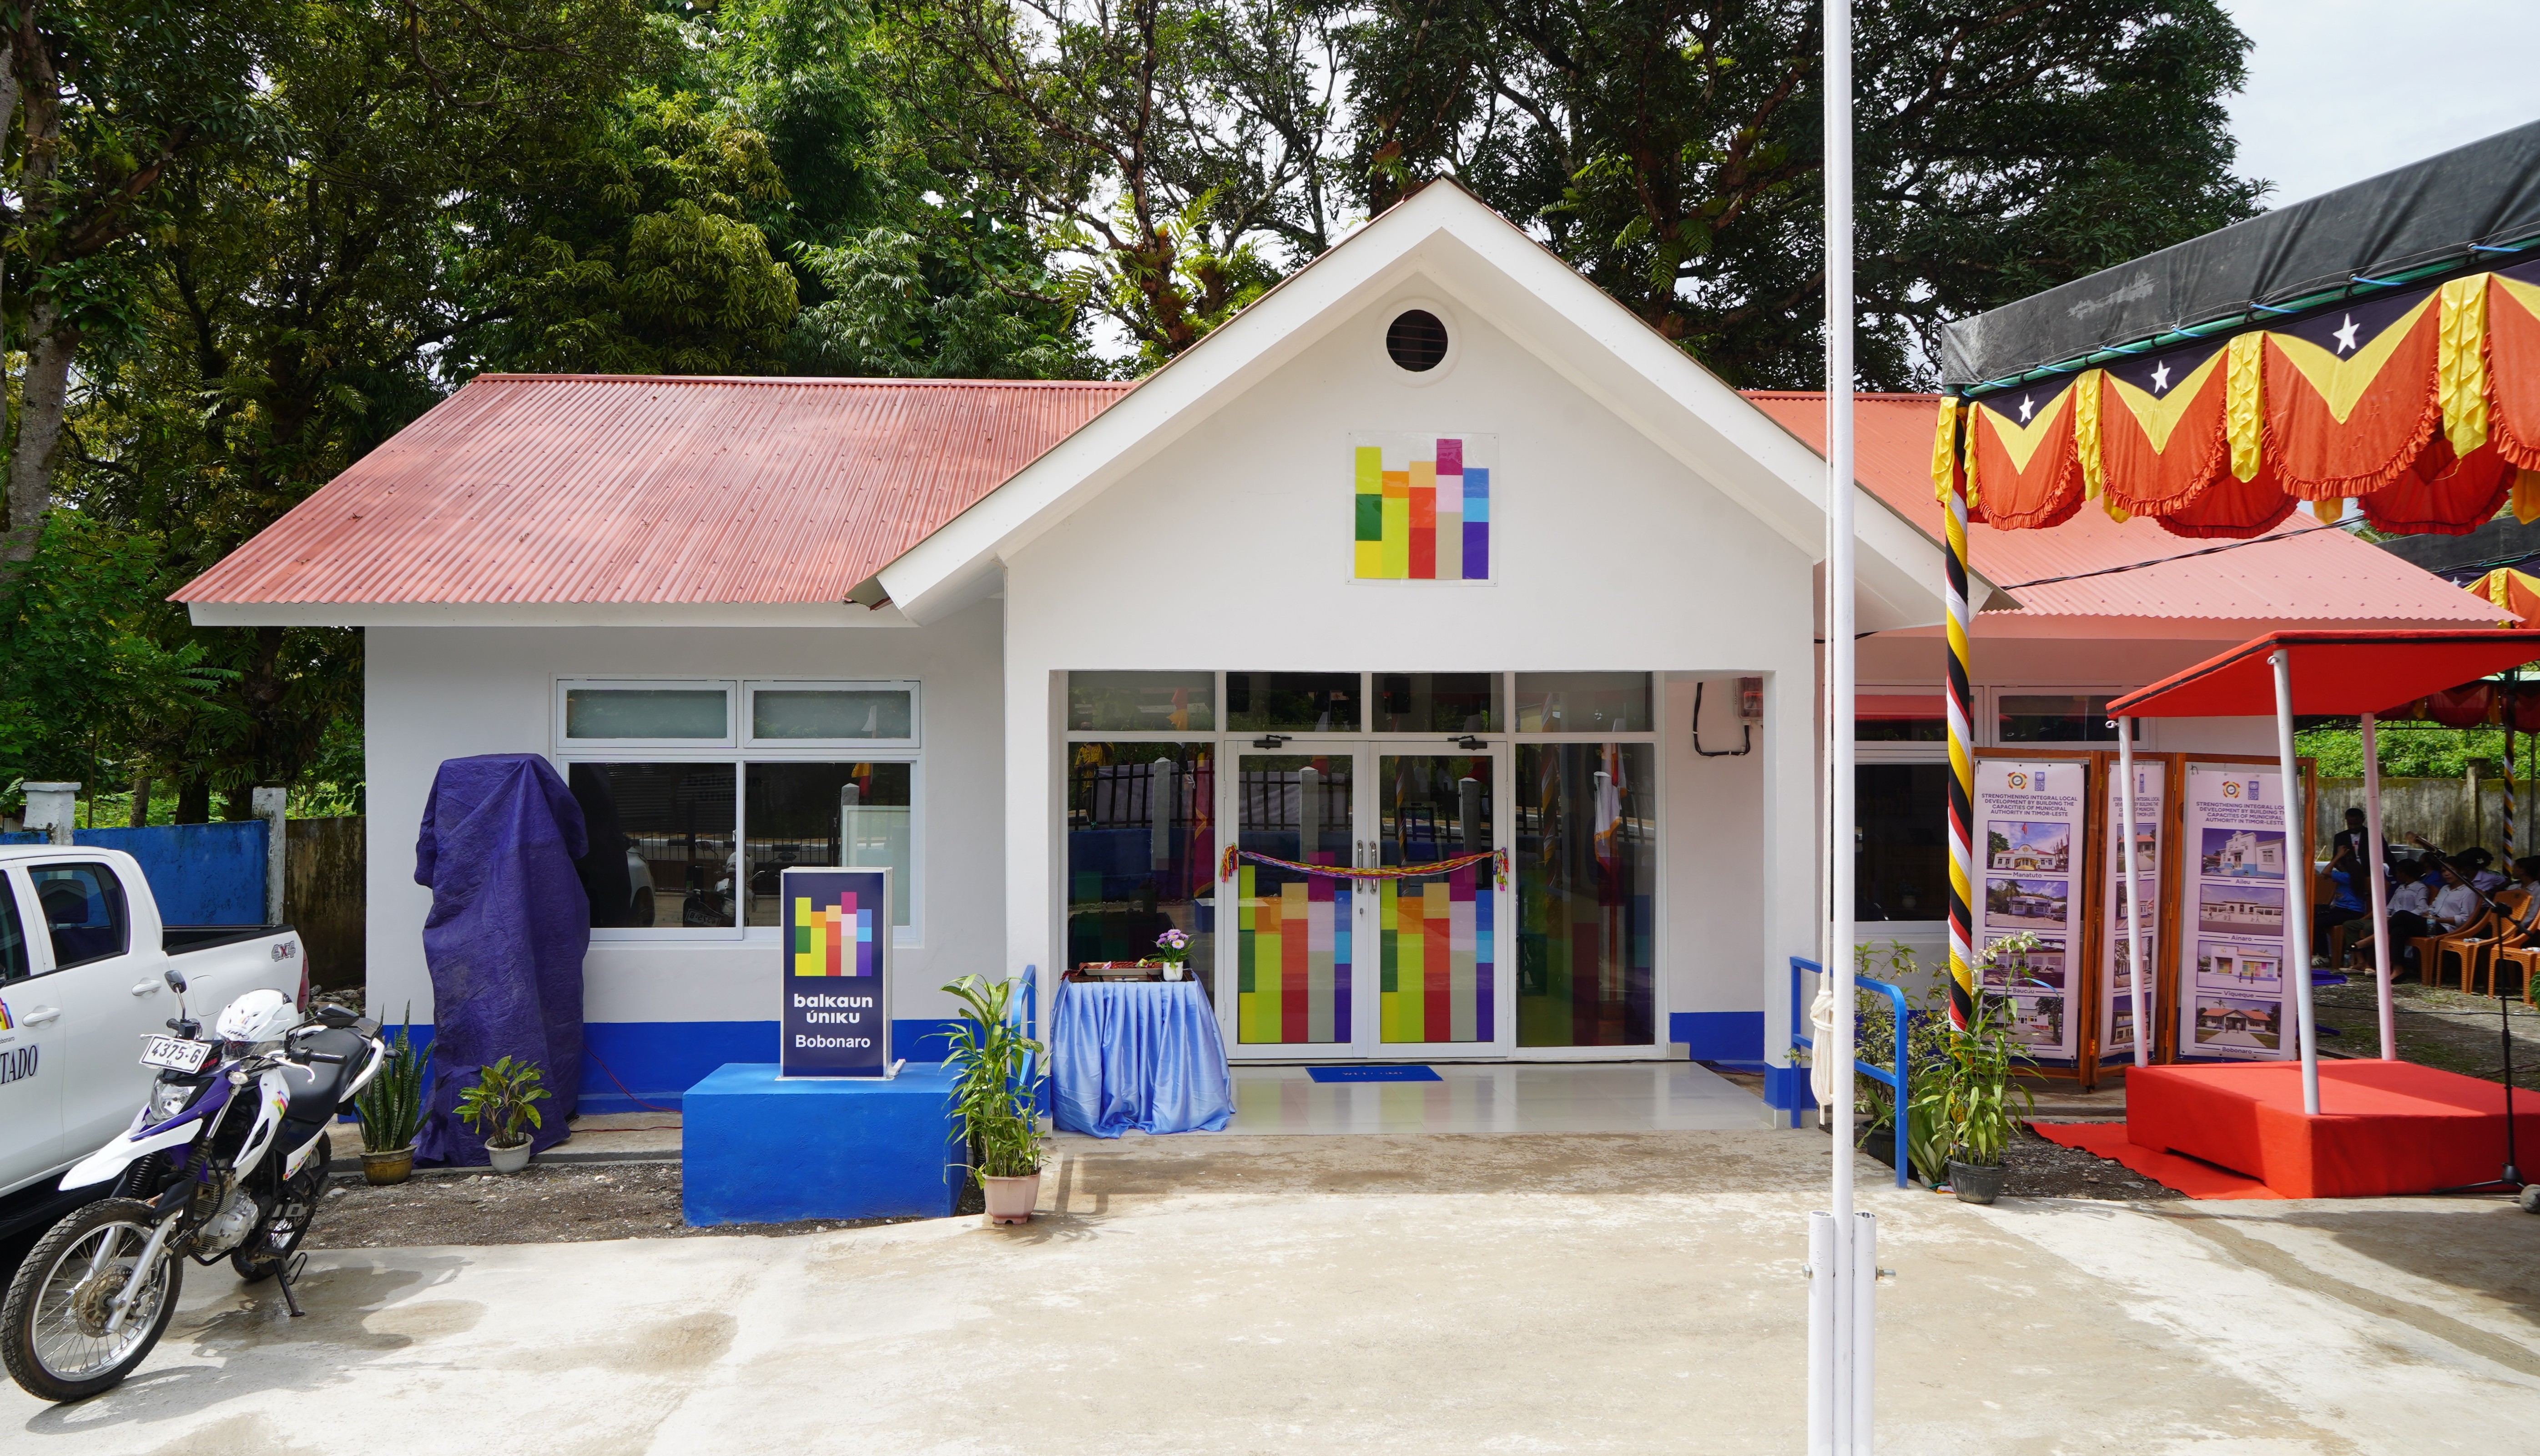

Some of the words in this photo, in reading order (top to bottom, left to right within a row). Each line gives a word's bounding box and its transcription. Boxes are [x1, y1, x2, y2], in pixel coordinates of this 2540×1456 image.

[794, 993, 872, 1008] balkaun
[806, 1010, 860, 1024] úniku
[796, 1034, 871, 1048] Bobonaro
[0, 1045, 38, 1084] TADO
